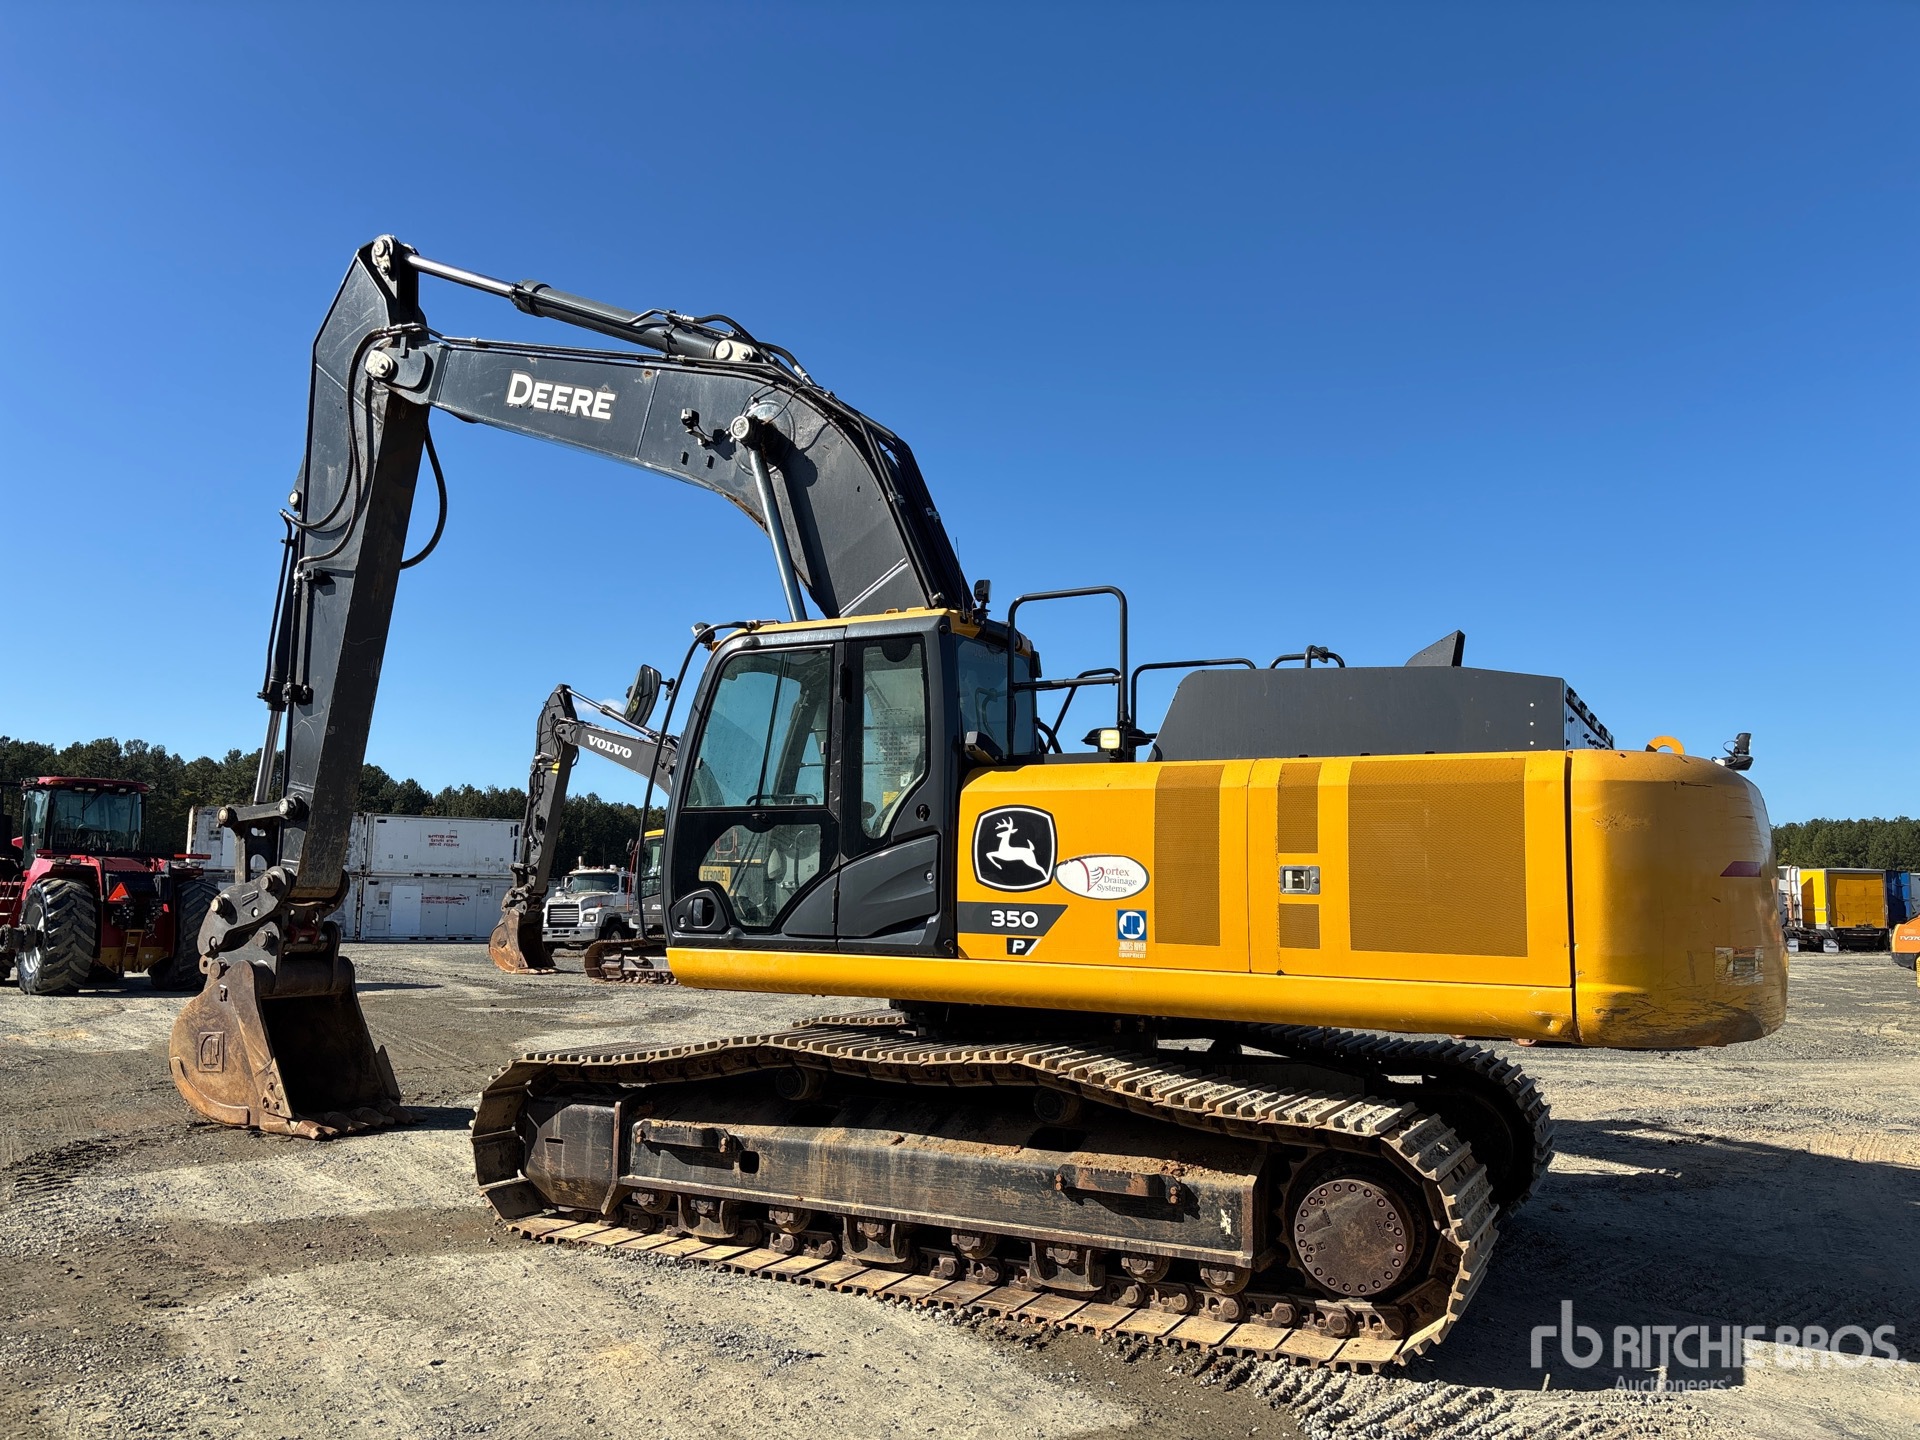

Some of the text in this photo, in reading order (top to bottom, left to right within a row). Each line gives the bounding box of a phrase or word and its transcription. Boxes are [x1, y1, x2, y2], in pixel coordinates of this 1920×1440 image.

[506, 372, 616, 420] DEERE
[587, 734, 632, 759] VOLVO
[1096, 883, 1127, 893] Systems
[1104, 875, 1137, 887] Drainage
[991, 910, 1039, 928] 350
[1012, 939, 1026, 954] P
